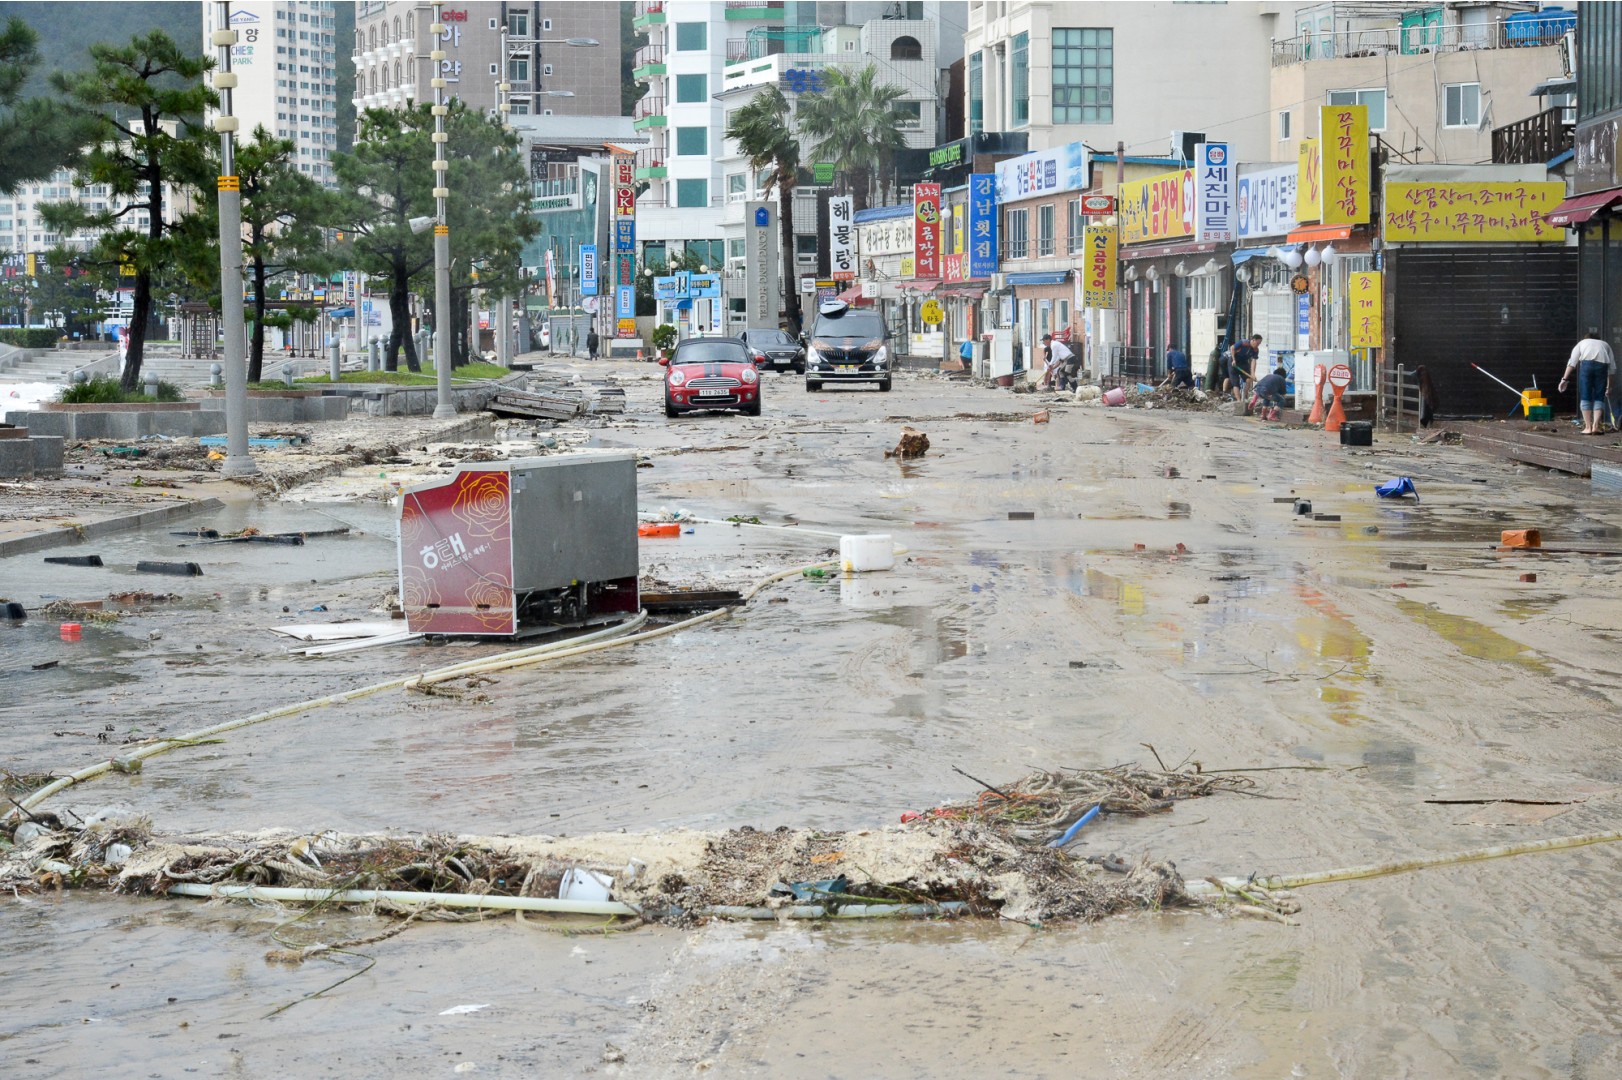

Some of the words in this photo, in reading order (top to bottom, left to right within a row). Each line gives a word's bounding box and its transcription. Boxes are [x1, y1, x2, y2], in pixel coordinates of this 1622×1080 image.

[441, 9, 468, 21] otel
[619, 188, 632, 207] OK
[974, 178, 993, 258] 강남횟집
[1205, 167, 1231, 231] 세진마트
[1250, 175, 1288, 233] 세진마트
[833, 201, 850, 270] 해물탕
[1203, 231, 1231, 241] 편의점
[1358, 276, 1373, 343] 조개구이
